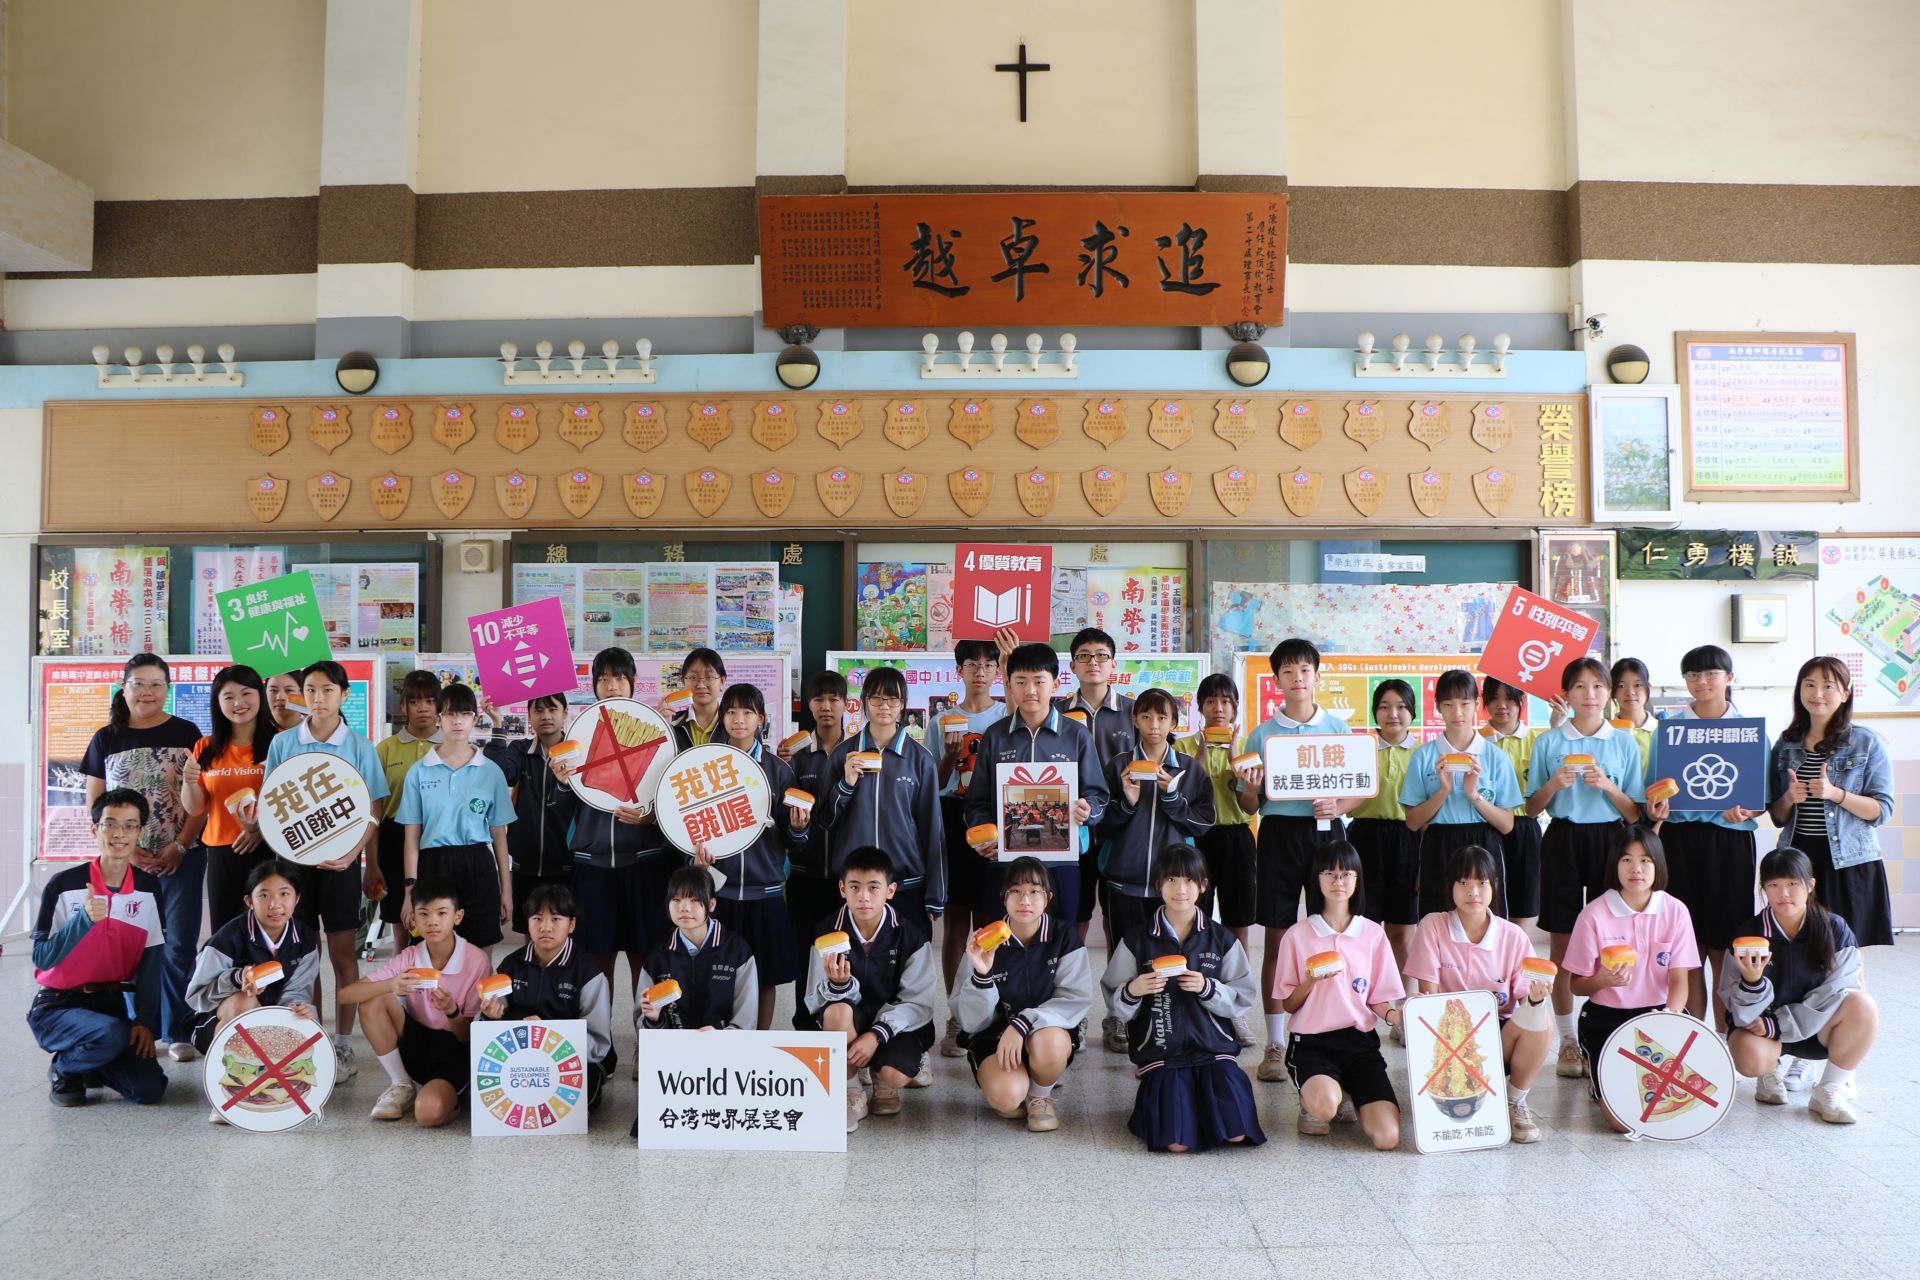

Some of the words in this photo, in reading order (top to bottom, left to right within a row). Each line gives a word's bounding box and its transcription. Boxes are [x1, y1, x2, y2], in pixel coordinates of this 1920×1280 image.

[902, 217, 1222, 303] 追求卓越
[1539, 404, 1576, 517] 榮譽榜
[964, 551, 975, 572] 4
[979, 554, 1042, 572] 優質教育
[1642, 541, 1801, 567] 仁勇樸誠
[48, 566, 71, 648] 校長室
[227, 598, 245, 622] 3
[246, 590, 269, 606] 良好
[248, 593, 308, 618] 健康與福祉
[1511, 594, 1524, 616] 5
[473, 621, 501, 647] 10
[500, 615, 524, 629] 減少
[503, 623, 539, 641] 不平等
[1528, 604, 1591, 641] 性別平等
[1427, 680, 1434, 691] 4
[1666, 726, 1683, 745] 17
[1687, 727, 1759, 743] 夥伴關係
[1296, 744, 1346, 769] 飢餓
[234, 767, 263, 775] Vision
[669, 754, 739, 806] 我好
[1273, 773, 1371, 790] 就是我的行動
[264, 761, 344, 824] 我在
[282, 796, 356, 850] 飢餓中
[682, 794, 757, 845] 餓喔
[1153, 1019, 1167, 1050] Nan
[510, 1078, 550, 1088] GOALS
[658, 1068, 727, 1096] World
[735, 1069, 804, 1096] Vision
[1432, 1130, 1462, 1141] 不能吃
[1465, 1126, 1495, 1138] 不能吃
